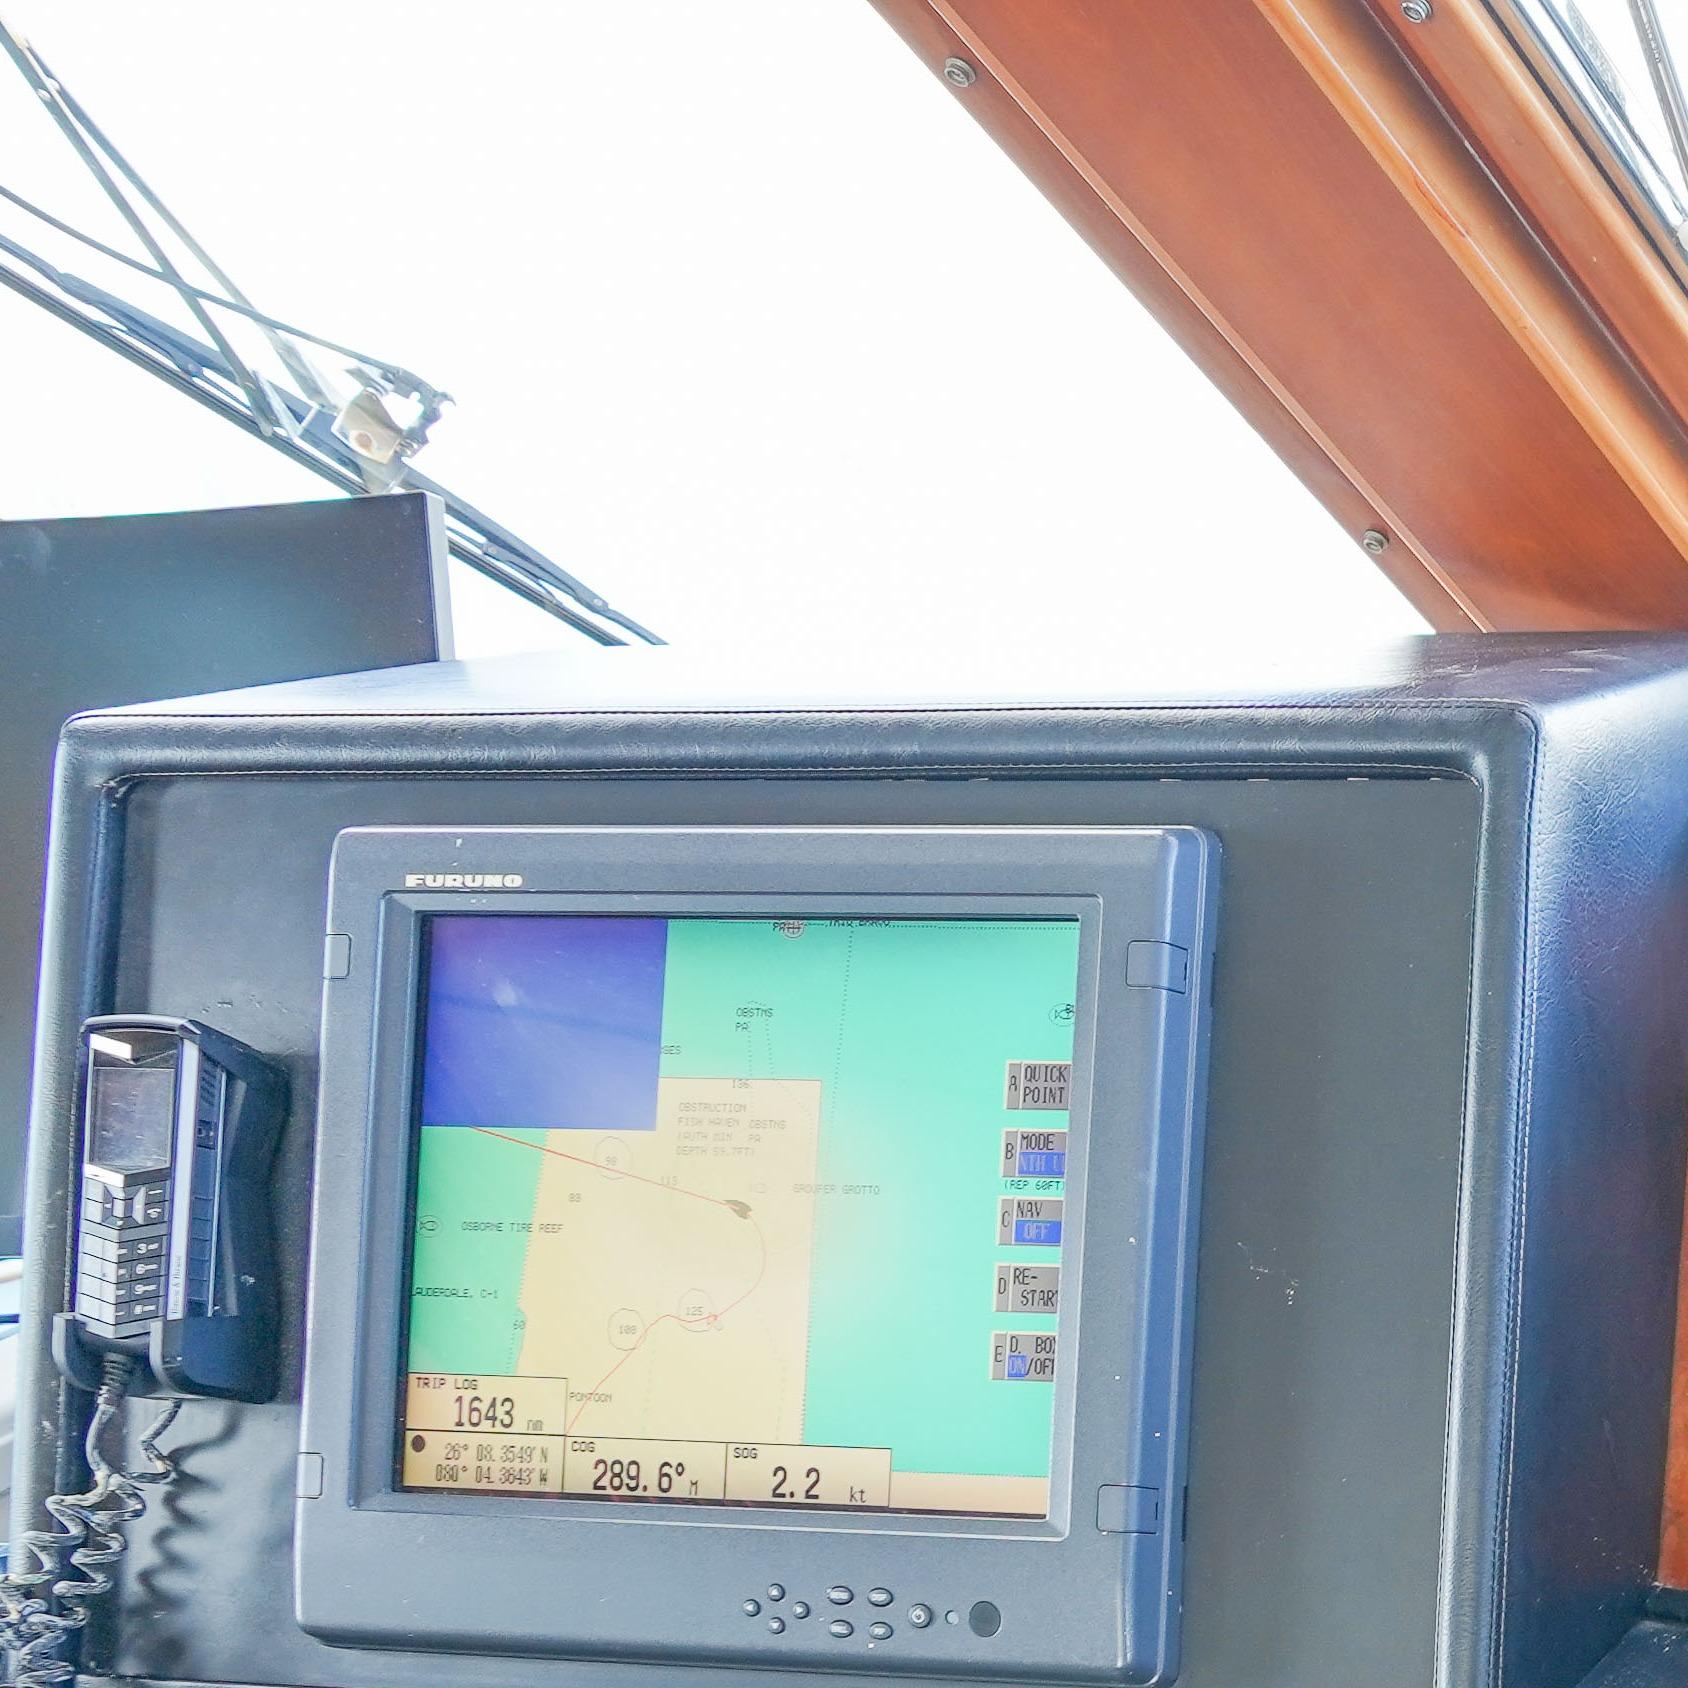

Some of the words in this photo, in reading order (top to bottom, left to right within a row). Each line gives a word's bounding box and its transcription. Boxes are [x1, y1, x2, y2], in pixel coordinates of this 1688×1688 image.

[405, 874, 523, 888] FURUNO
[1024, 1064, 1067, 1083] QUICK
[1008, 1074, 1017, 1092] A
[1022, 1086, 1064, 1104] POINT
[1005, 1142, 1014, 1160] B
[1020, 1133, 1055, 1151] MODE
[1016, 1201, 1042, 1218] NAV
[509, 1222, 533, 1233] TIRE
[539, 1223, 564, 1234] REEF
[1001, 1210, 1010, 1228] C
[1023, 1222, 1050, 1240] OFF
[1013, 1267, 1038, 1286] RE-
[998, 1277, 1007, 1295] D
[994, 1345, 1003, 1363] E
[415, 1376, 446, 1390] TRIP
[454, 1378, 478, 1391] LOG
[454, 1395, 515, 1429] 1643
[571, 1440, 595, 1453] COG
[734, 1446, 758, 1460] SOG
[771, 1465, 820, 1500] 2.2
[849, 1486, 866, 1504] kt
